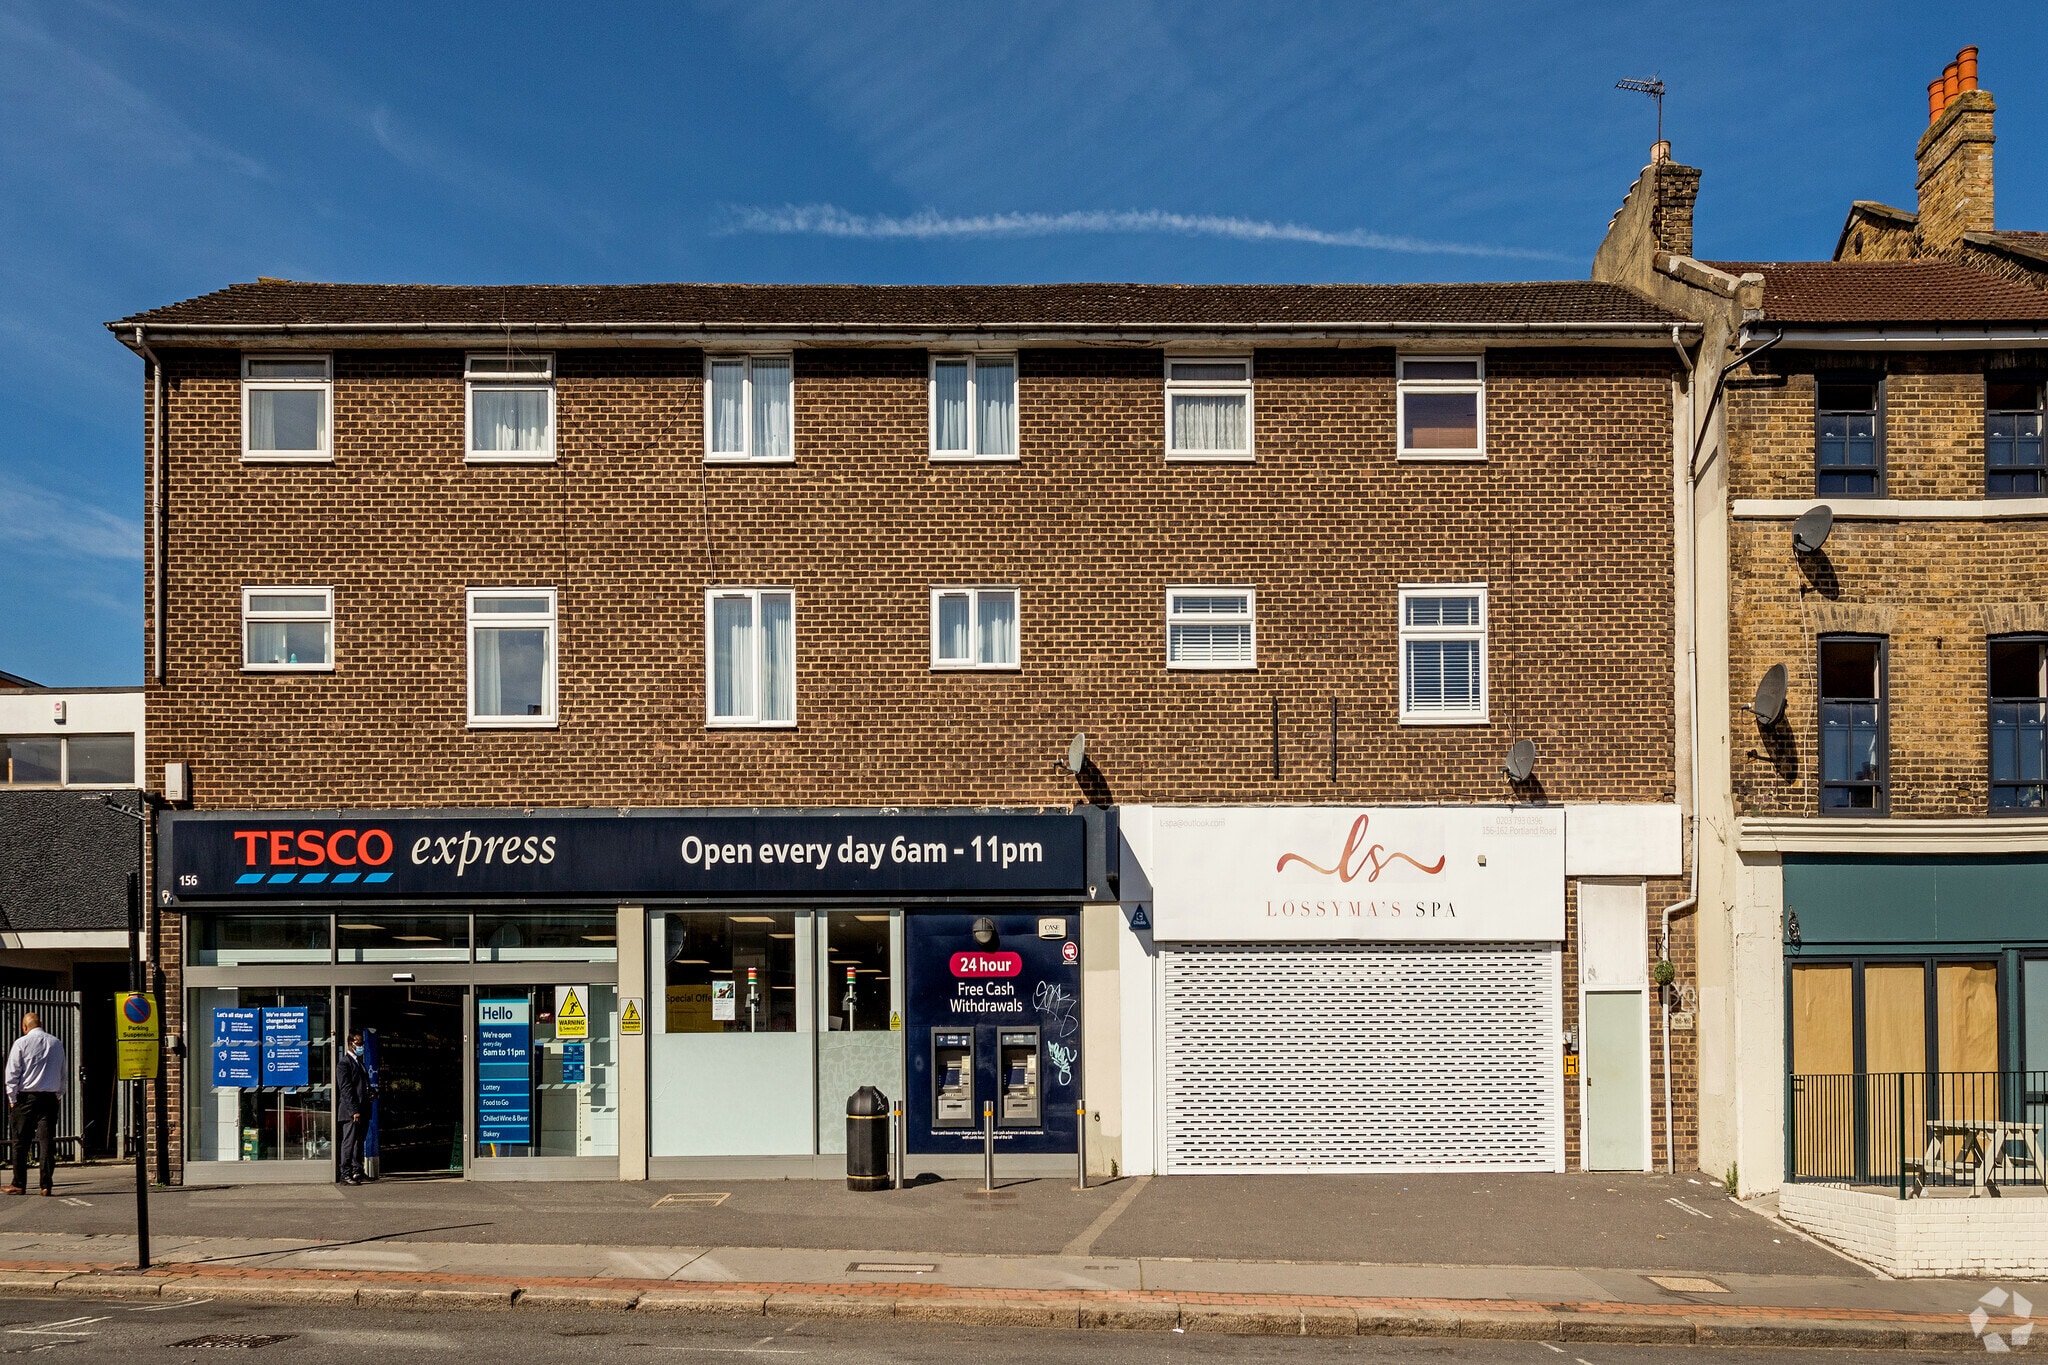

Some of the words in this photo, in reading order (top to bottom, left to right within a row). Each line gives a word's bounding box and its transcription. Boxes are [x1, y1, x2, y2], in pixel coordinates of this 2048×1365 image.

[1514, 816, 1526, 825] 793
[1509, 826, 1539, 835] Portland
[1539, 826, 1557, 835] Road
[234, 829, 394, 866] TESCO
[411, 830, 557, 877] express
[681, 836, 753, 870] Open
[759, 843, 832, 870] every
[837, 836, 886, 870] day
[891, 836, 947, 863] 6am
[971, 835, 1043, 869] 11pm
[179, 875, 198, 886] 156
[1266, 900, 1402, 917] LOSSYMA'S
[1415, 901, 1457, 917] SPA
[960, 957, 977, 972] 24
[980, 956, 1012, 972] hour
[958, 982, 984, 996] Free
[986, 981, 1015, 996] Cash
[665, 993, 694, 1004] Special
[695, 993, 712, 1002] Offe
[950, 998, 1023, 1013] Withdrawals
[482, 1006, 513, 1020] Hello
[498, 1032, 512, 1040] open
[482, 1048, 499, 1056] 6am
[507, 1048, 526, 1057] 11pm
[1566, 1057, 1577, 1073] H
[482, 1084, 501, 1092] Lottery
[482, 1131, 501, 1139] Bakery
